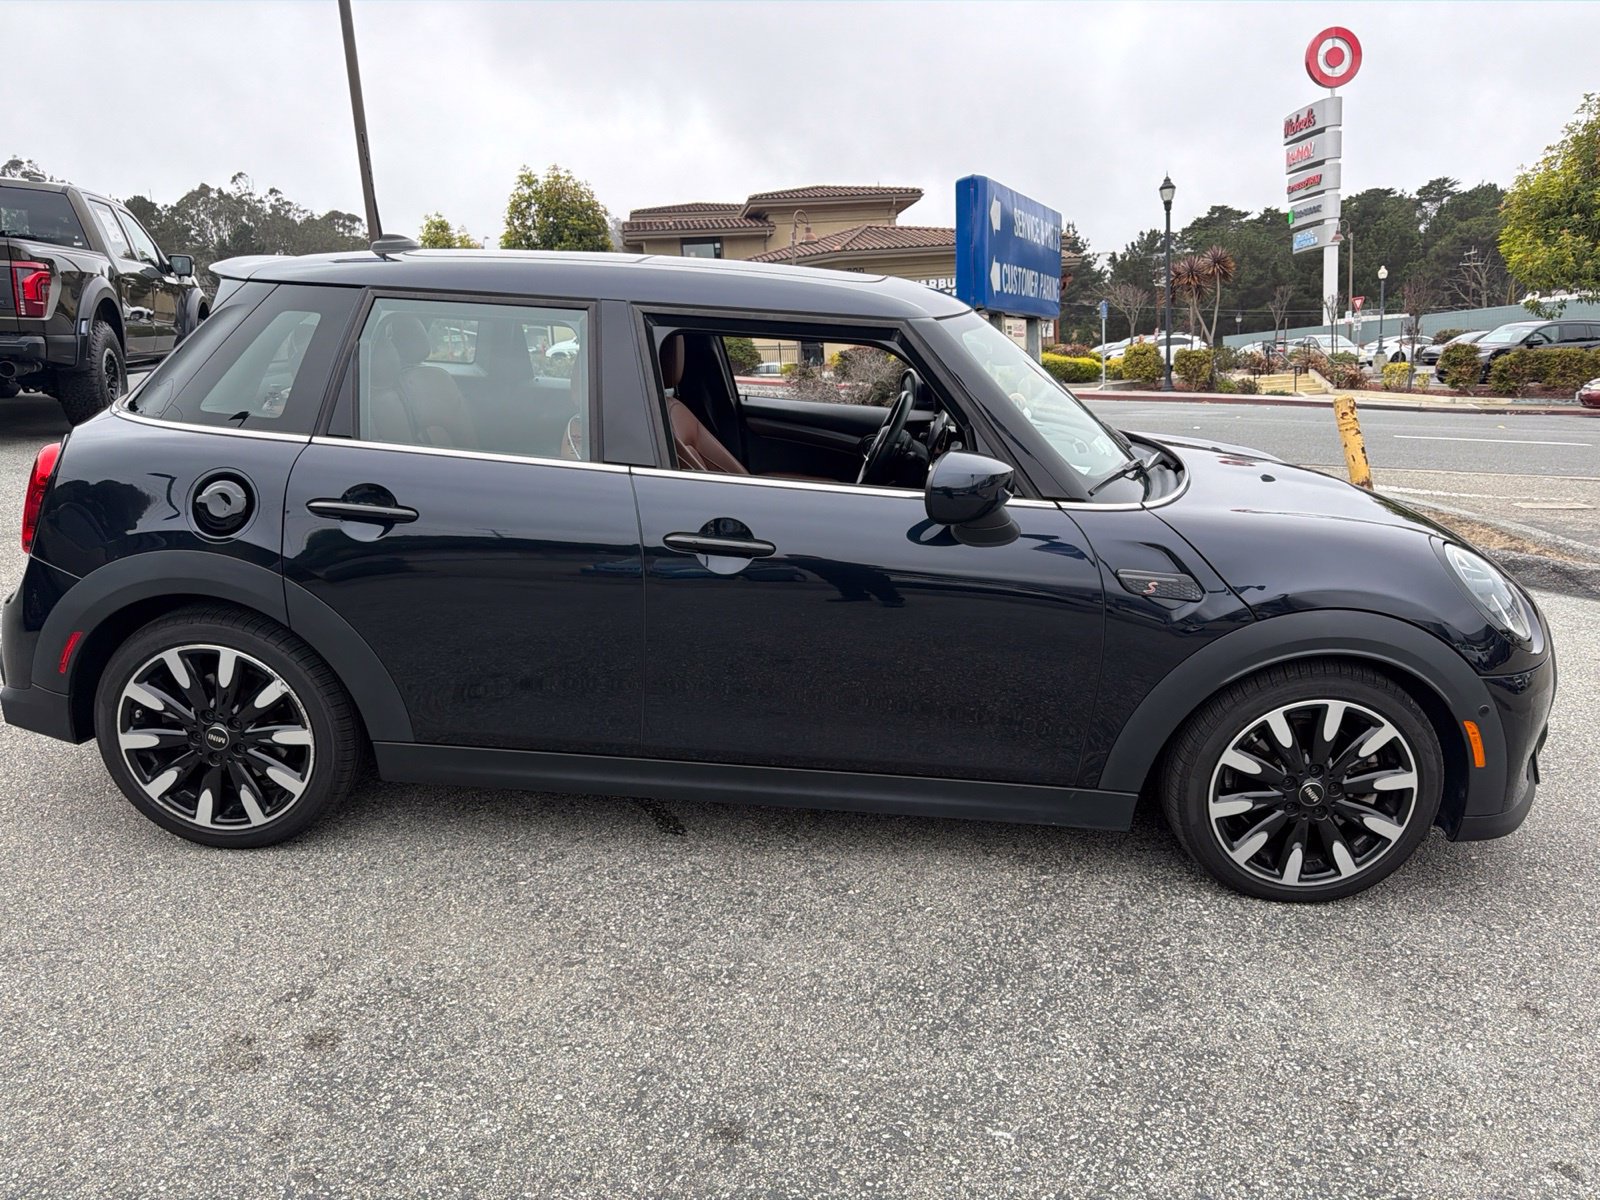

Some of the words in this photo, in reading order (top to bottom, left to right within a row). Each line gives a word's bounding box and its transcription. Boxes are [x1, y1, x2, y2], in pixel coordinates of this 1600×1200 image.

[1013, 207, 1040, 245] SERVICE
[1002, 263, 1039, 299] CUSTOMER
[1039, 272, 1060, 303] PARKING
[1142, 581, 1159, 595] S
[208, 733, 226, 744] MINI
[1304, 786, 1320, 802] MINI
